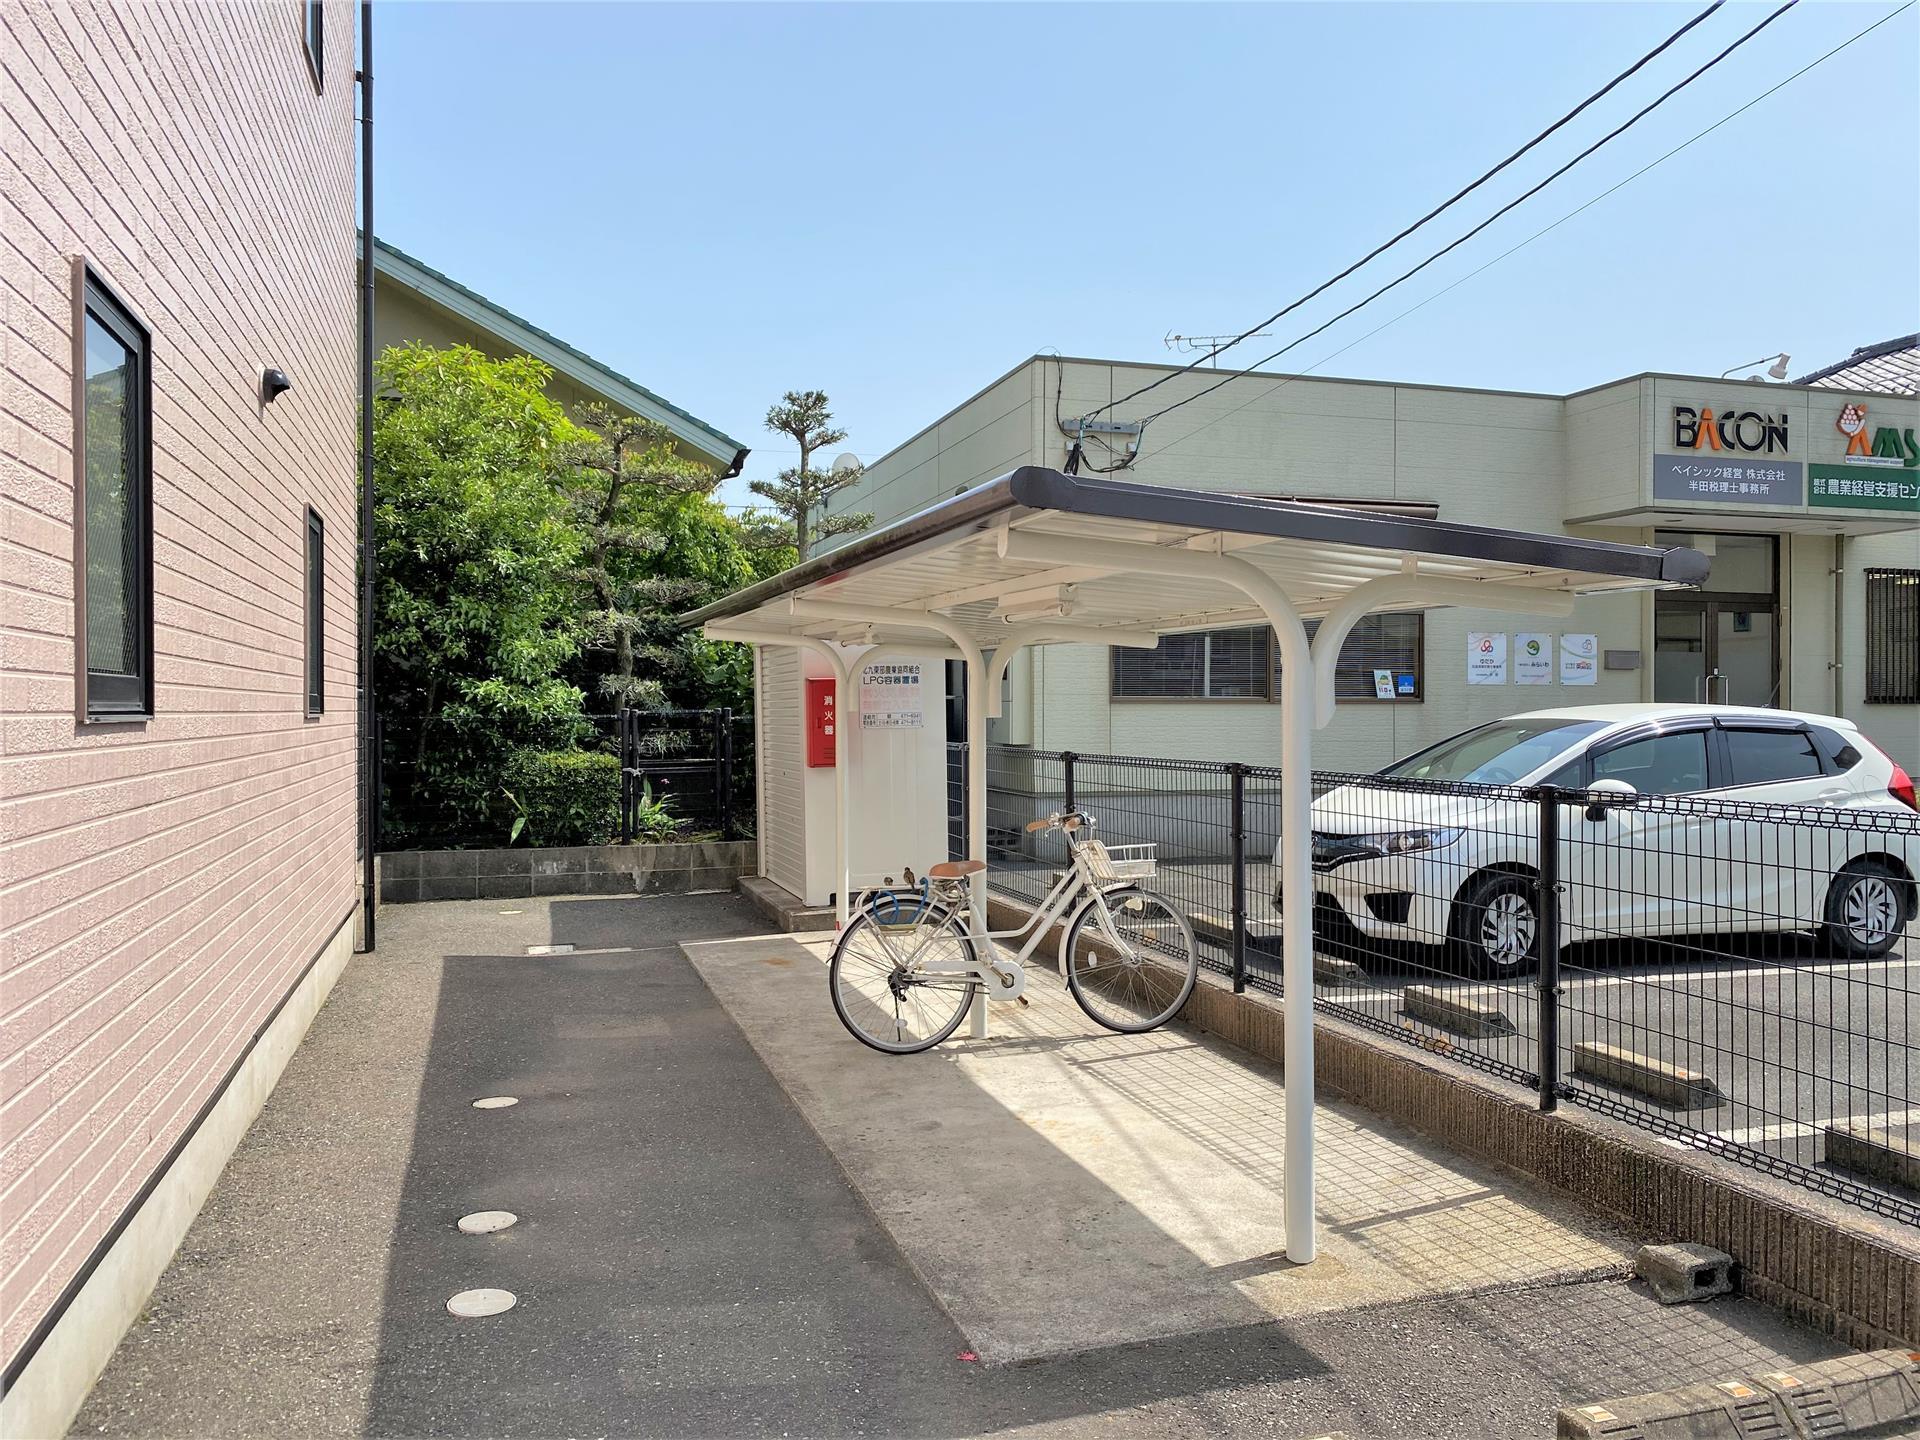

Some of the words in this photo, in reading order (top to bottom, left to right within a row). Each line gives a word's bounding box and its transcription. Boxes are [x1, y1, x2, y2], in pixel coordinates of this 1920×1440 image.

[1673, 406, 1789, 454] BACON
[1672, 465, 1743, 479] ベイシック経営
[1746, 468, 1786, 481] 株式会社
[1688, 480, 1770, 495] 半田税理士事務所
[823, 695, 834, 735] 消火器
